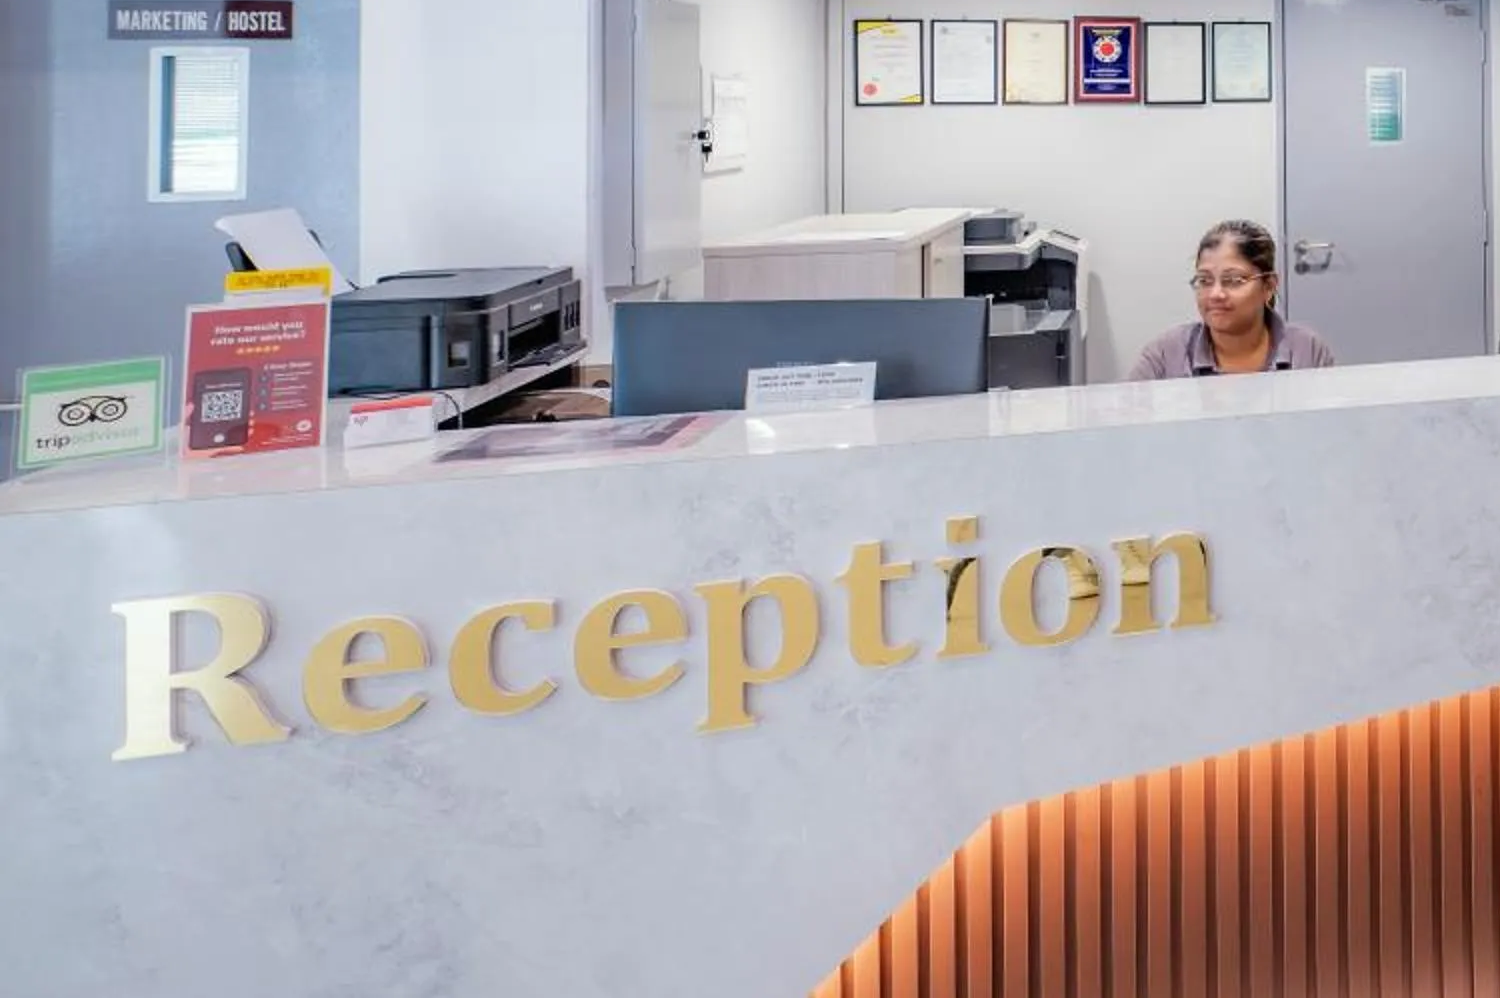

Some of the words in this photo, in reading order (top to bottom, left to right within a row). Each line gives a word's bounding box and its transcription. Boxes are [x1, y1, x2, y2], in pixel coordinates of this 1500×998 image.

[116, 10, 208, 31] MARKETING
[228, 11, 286, 31] HOSTEL
[111, 515, 1221, 761] Reception
